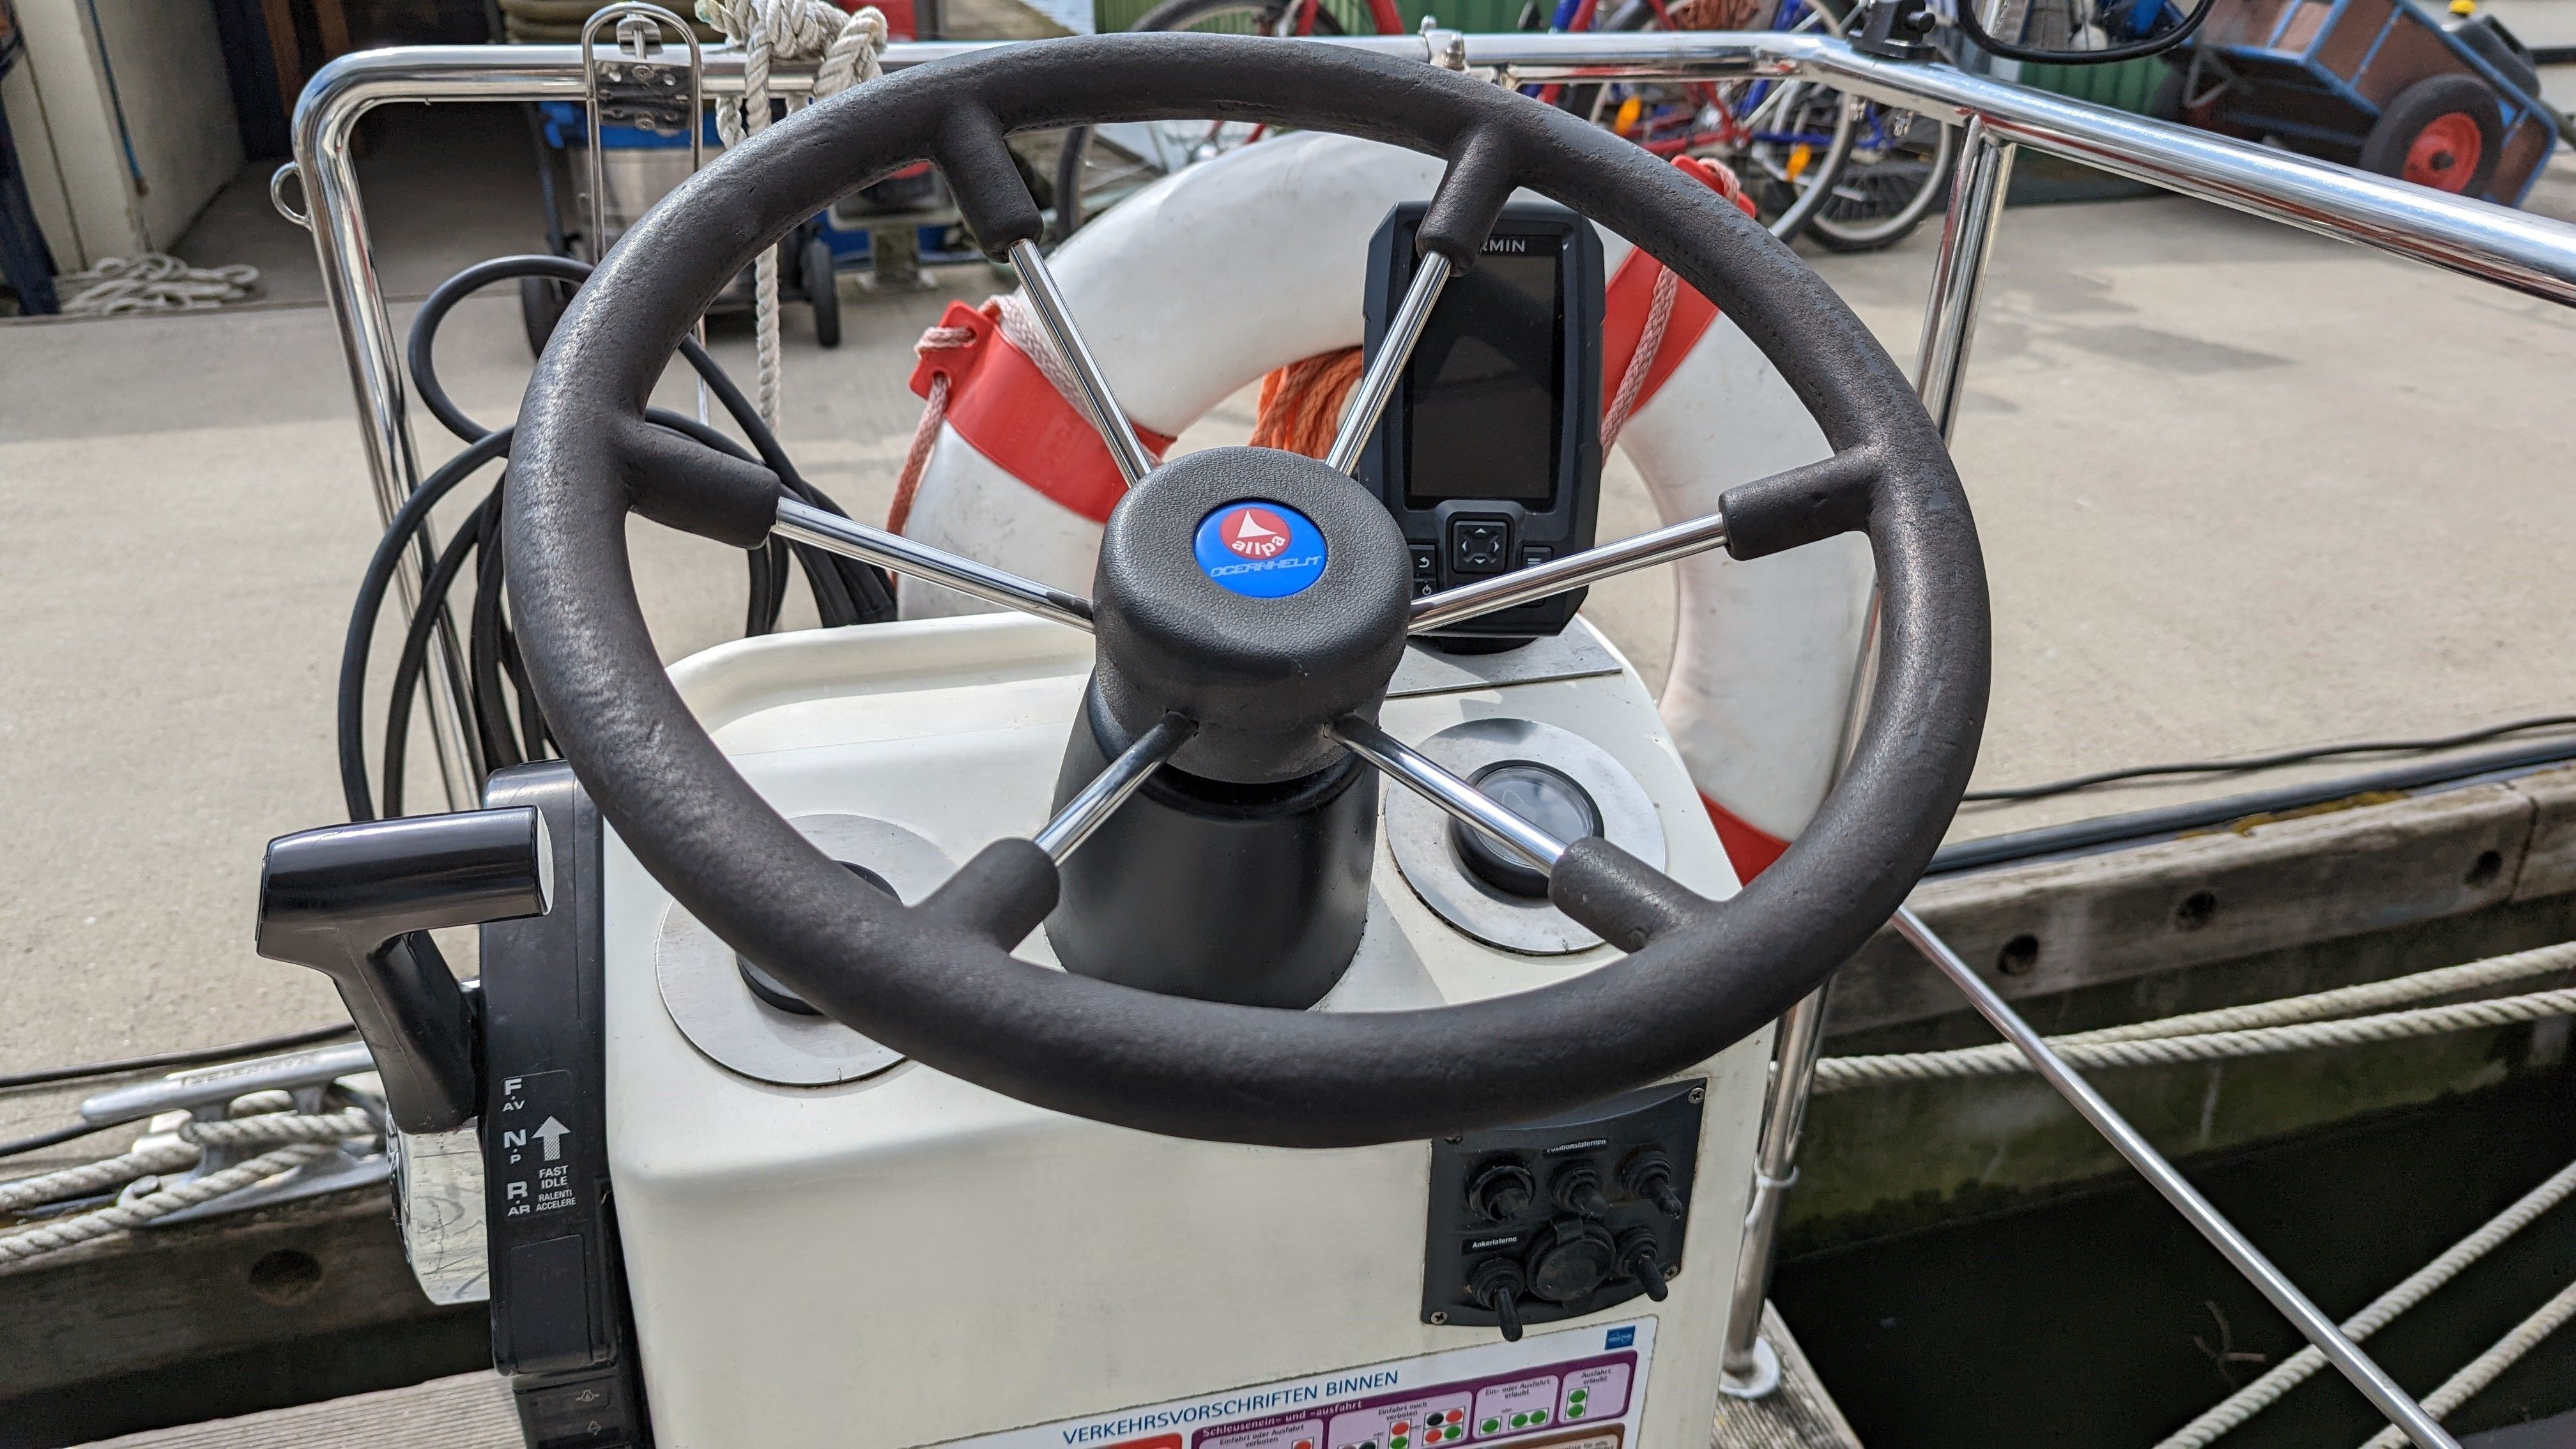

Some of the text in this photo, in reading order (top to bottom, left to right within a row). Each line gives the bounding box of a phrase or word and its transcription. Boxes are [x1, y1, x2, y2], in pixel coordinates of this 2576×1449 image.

[1231, 535, 1286, 557] allpa
[1209, 555, 1322, 578] OCEANHELM
[503, 1078, 523, 1096] F
[502, 1100, 525, 1112] AV
[503, 1129, 527, 1149] N
[510, 1154, 521, 1164] P
[539, 1165, 569, 1179] FAST
[507, 1181, 528, 1200] R
[541, 1176, 568, 1190] IDLE
[539, 1188, 572, 1202] RALENTI
[507, 1204, 531, 1217] AR
[535, 1197, 577, 1212] ACCELERE
[1472, 1236, 1518, 1248] Ankerlaterne
[1062, 1370, 1398, 1445] VERKEHRSVORSCHRIFTEN BINNEN
[1202, 1400, 1363, 1438] Schleusenein- und -ausfahrt
